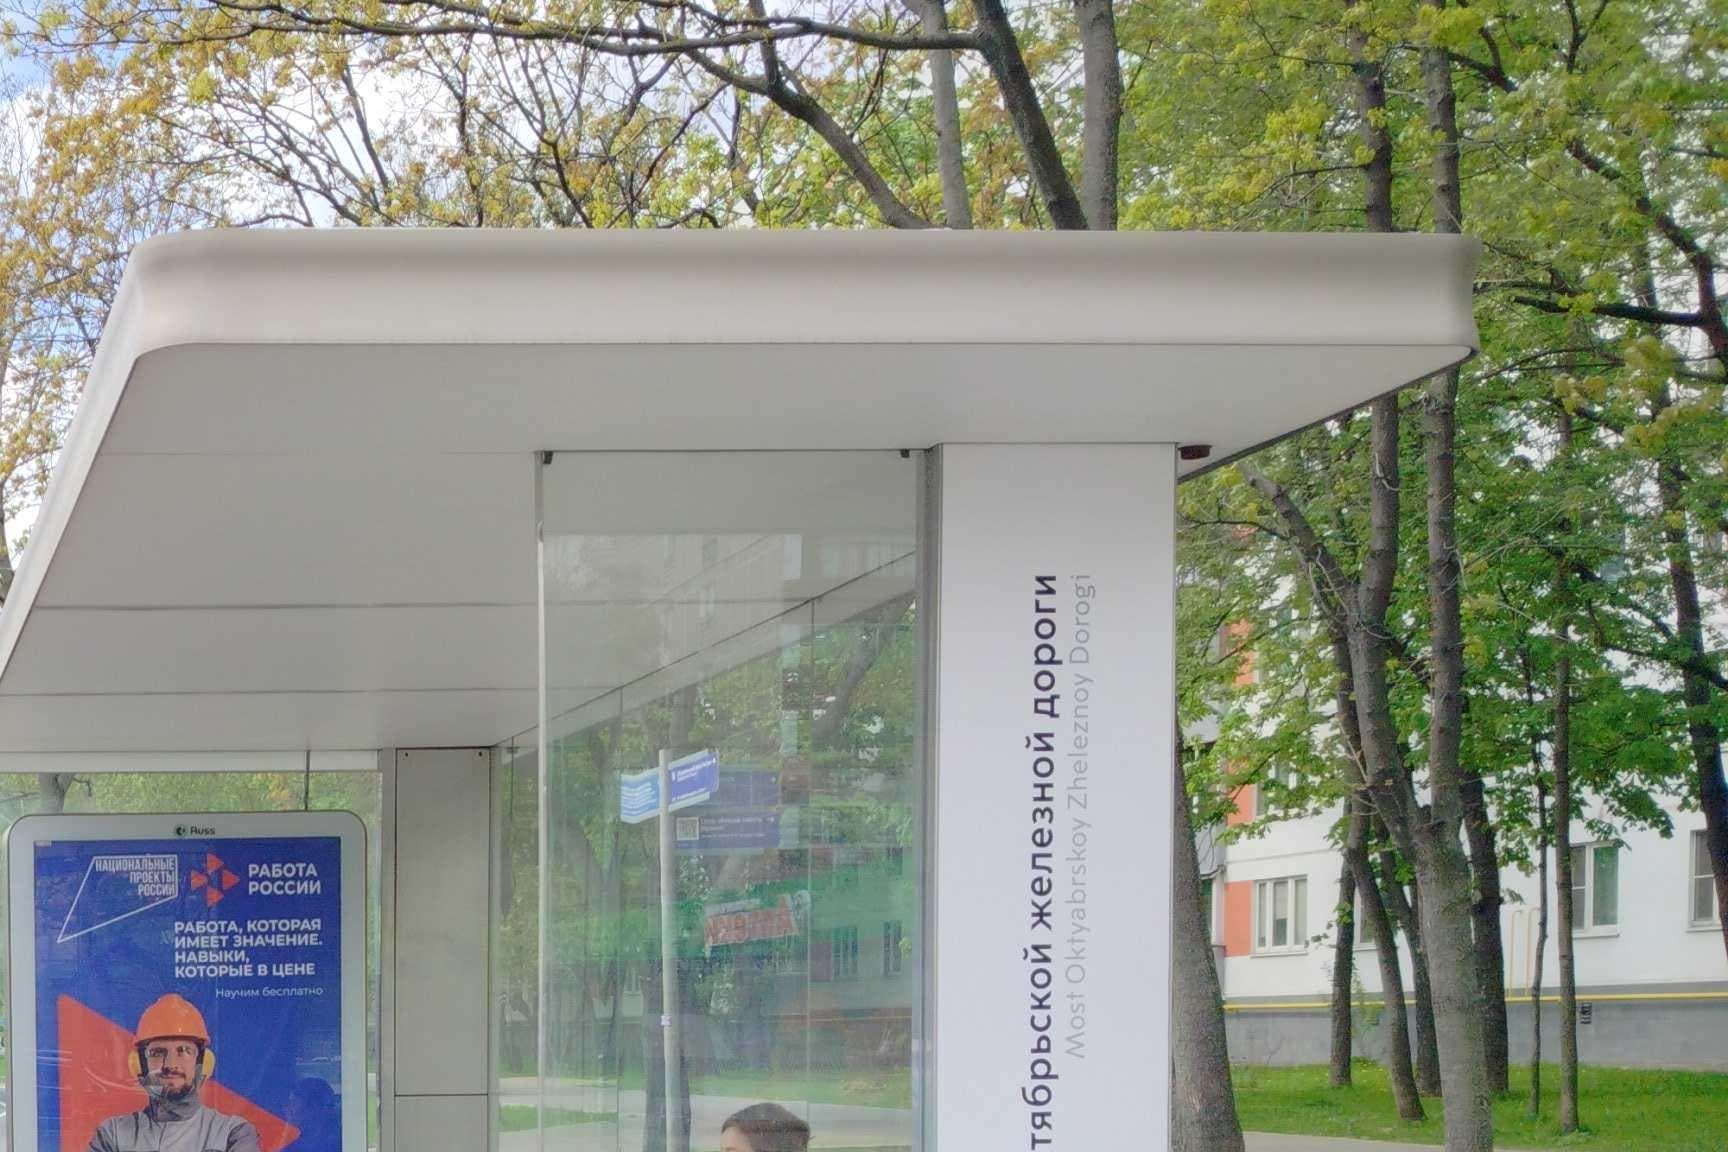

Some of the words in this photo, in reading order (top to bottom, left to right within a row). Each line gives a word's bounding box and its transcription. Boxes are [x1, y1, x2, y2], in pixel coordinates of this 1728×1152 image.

[1069, 574, 1096, 665] Dorogi
[1033, 575, 1063, 719] дороги
[1067, 671, 1094, 810] Zheleznoy
[1025, 731, 1055, 931] железной
[95, 857, 175, 872] НАЦИОНАЛЬНЫЕ
[248, 862, 318, 878] РАБОТА
[129, 871, 175, 884] ПРОЕКТЫ
[137, 884, 175, 897] РОССИИ
[248, 880, 321, 896] РОССИИ
[1064, 816, 1092, 985] Oktyabrskoy
[174, 920, 243, 935] РАБОТА,
[247, 918, 321, 932] КОТОРАЯ
[174, 935, 229, 949] ИМЕЕТ
[233, 933, 323, 948] ЗНАЧЕНИЕ.
[174, 950, 250, 964] НАВЫКИ,
[174, 964, 253, 978] КОТОРЫЕ
[257, 963, 268, 976] В
[272, 963, 315, 978] ЦЕНЕ
[215, 987, 260, 999] Научим
[262, 985, 324, 998] бесплатно
[1064, 991, 1086, 1059] Most
